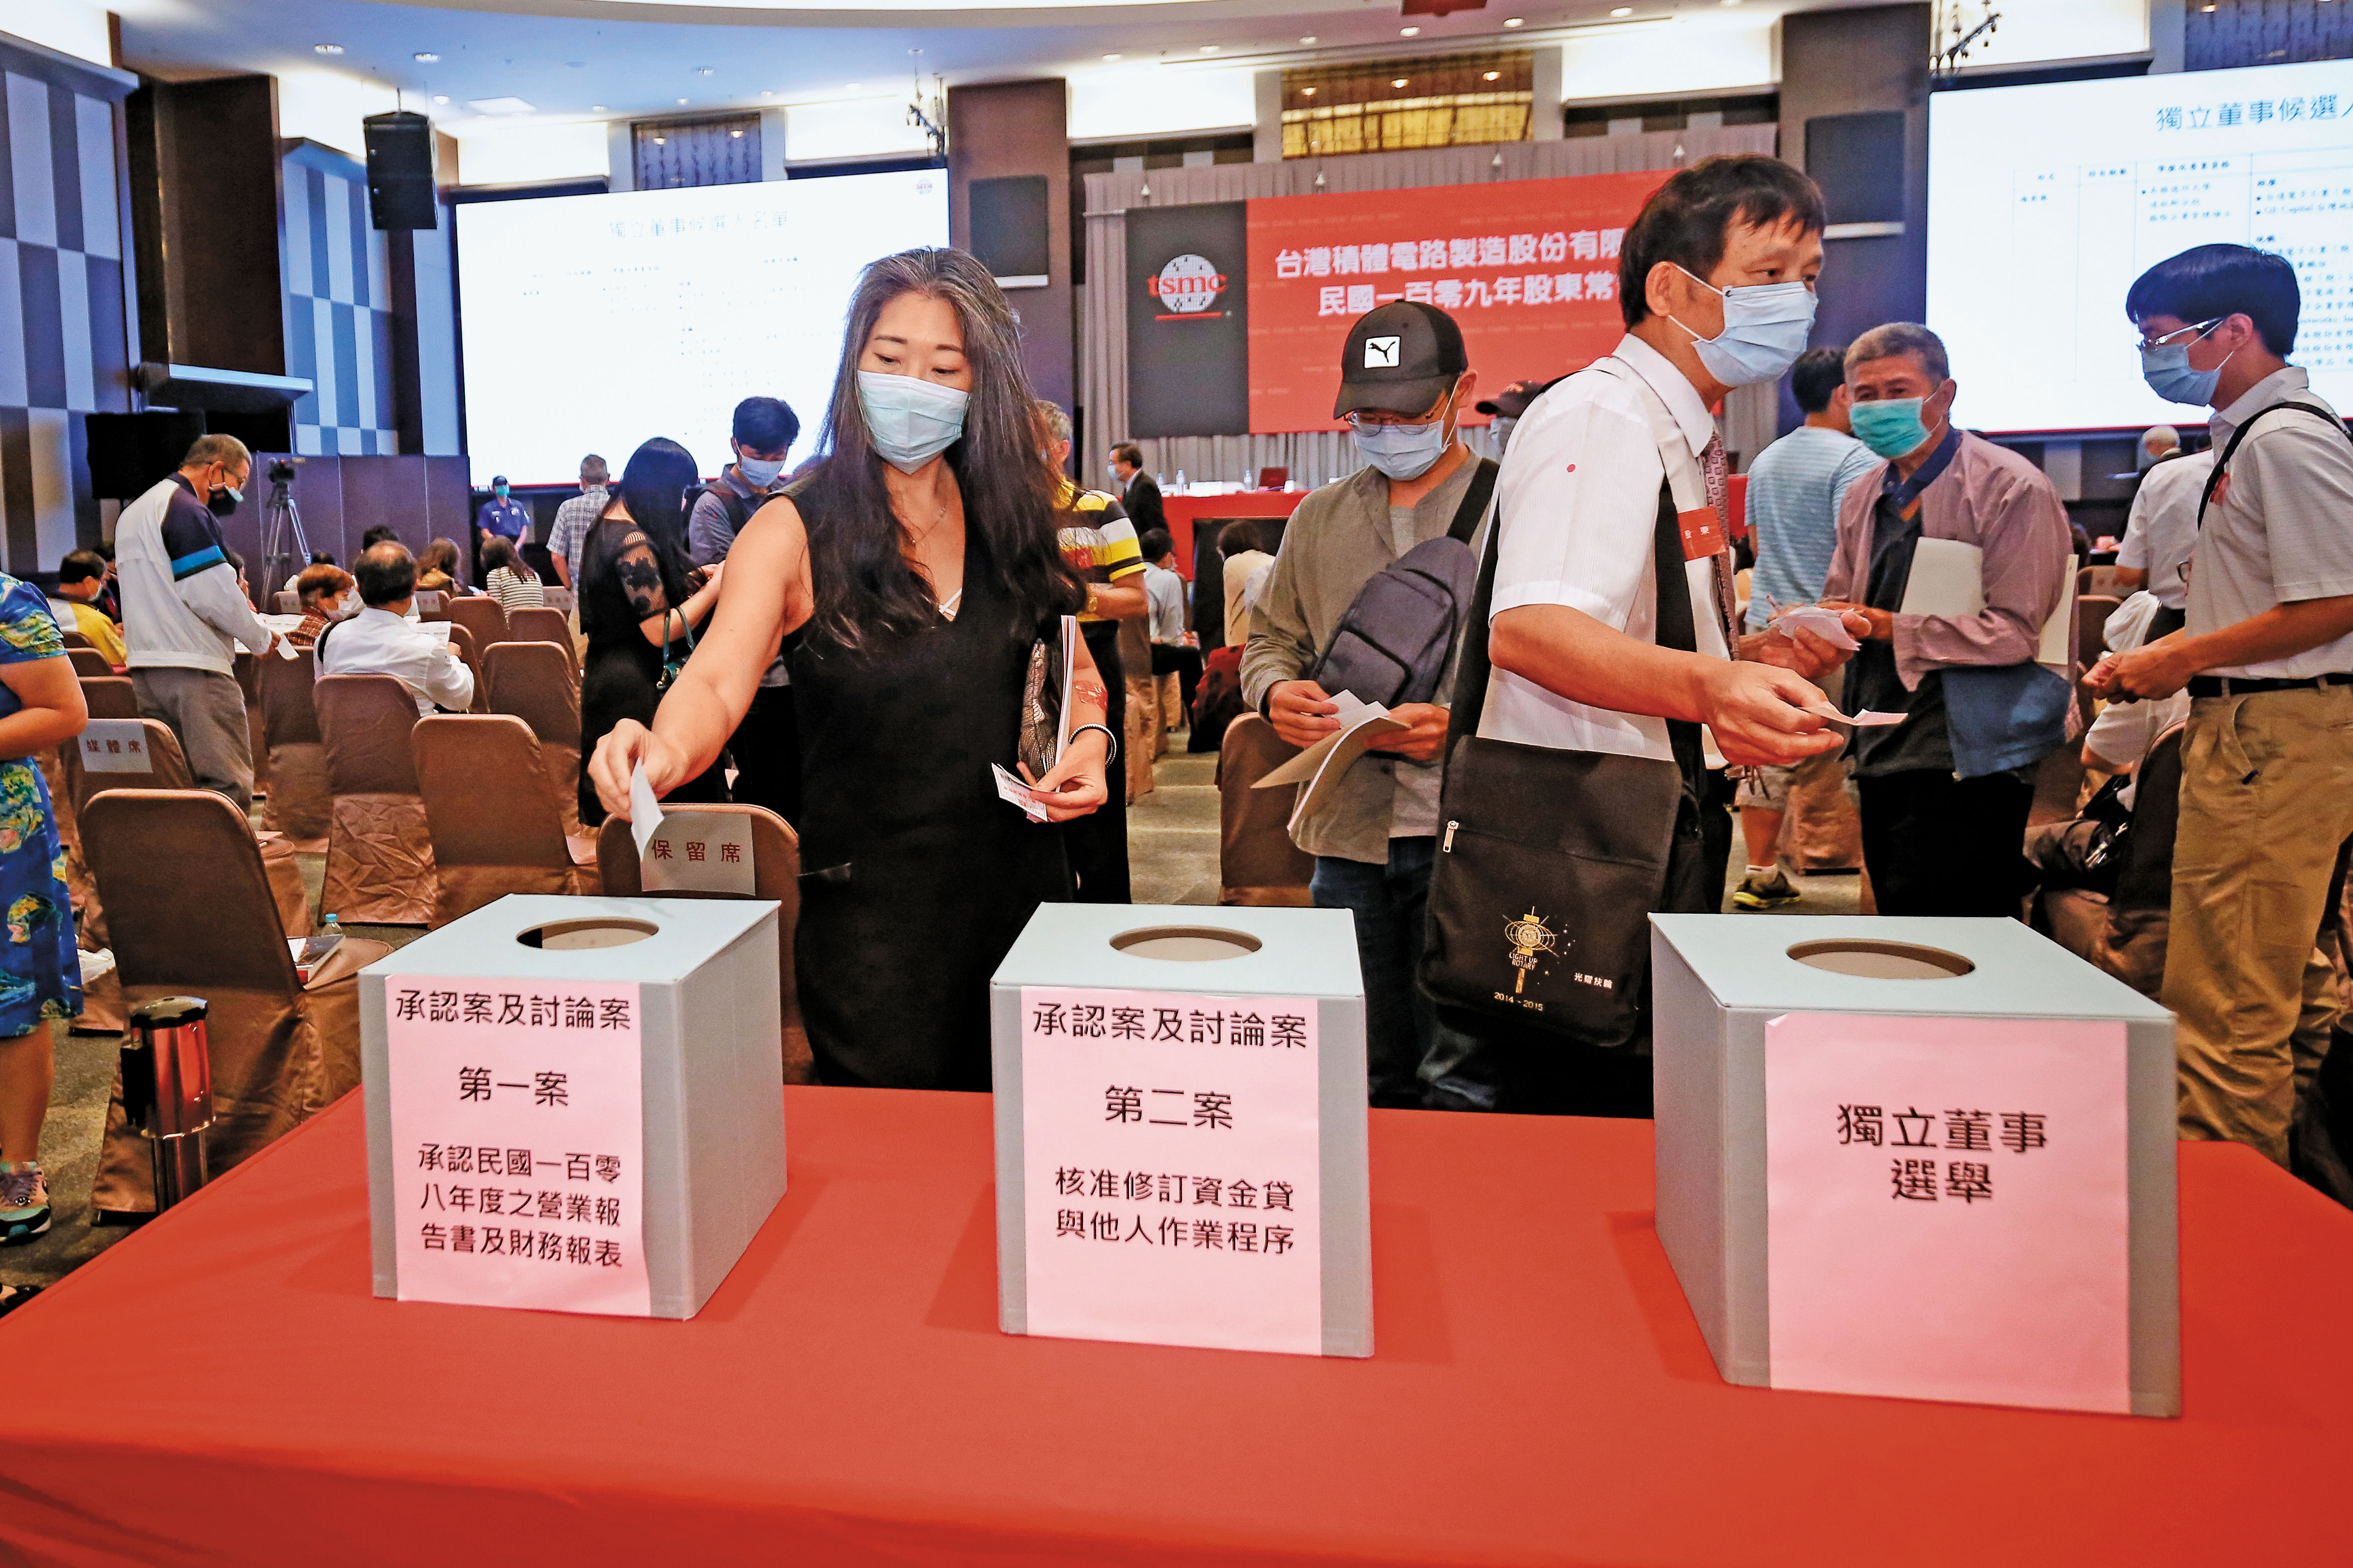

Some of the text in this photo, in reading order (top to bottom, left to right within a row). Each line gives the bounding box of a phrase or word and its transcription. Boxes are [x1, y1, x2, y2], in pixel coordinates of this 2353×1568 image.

[1275, 228, 1625, 278] 台灣積體電路製造股份有限
[1147, 274, 1228, 297] tsmc
[1319, 271, 1620, 316] 民國一百零九年股東常
[651, 838, 741, 863] 保留席
[1509, 952, 1538, 964] LIGHT UP
[1512, 959, 1536, 970] ROTARY
[396, 989, 631, 1030] 承認案及討論案
[1494, 992, 1514, 1003] 2014
[1523, 1000, 1543, 1011] 2015
[1033, 1002, 1307, 1048] 承認案及討論案
[458, 1066, 569, 1107] 第一案
[1105, 1084, 1233, 1129] 第二案
[1837, 1104, 2047, 1154] 獨立董事
[418, 1143, 621, 1184] 承認民國一百零
[1890, 1158, 1993, 1204] 選舉
[420, 1182, 621, 1228] 八年度之營業報
[1055, 1165, 1294, 1212] 核准修訂資金貸
[421, 1222, 623, 1268] 告書及財務報表
[1056, 1208, 1294, 1254] 與他人作業程序
